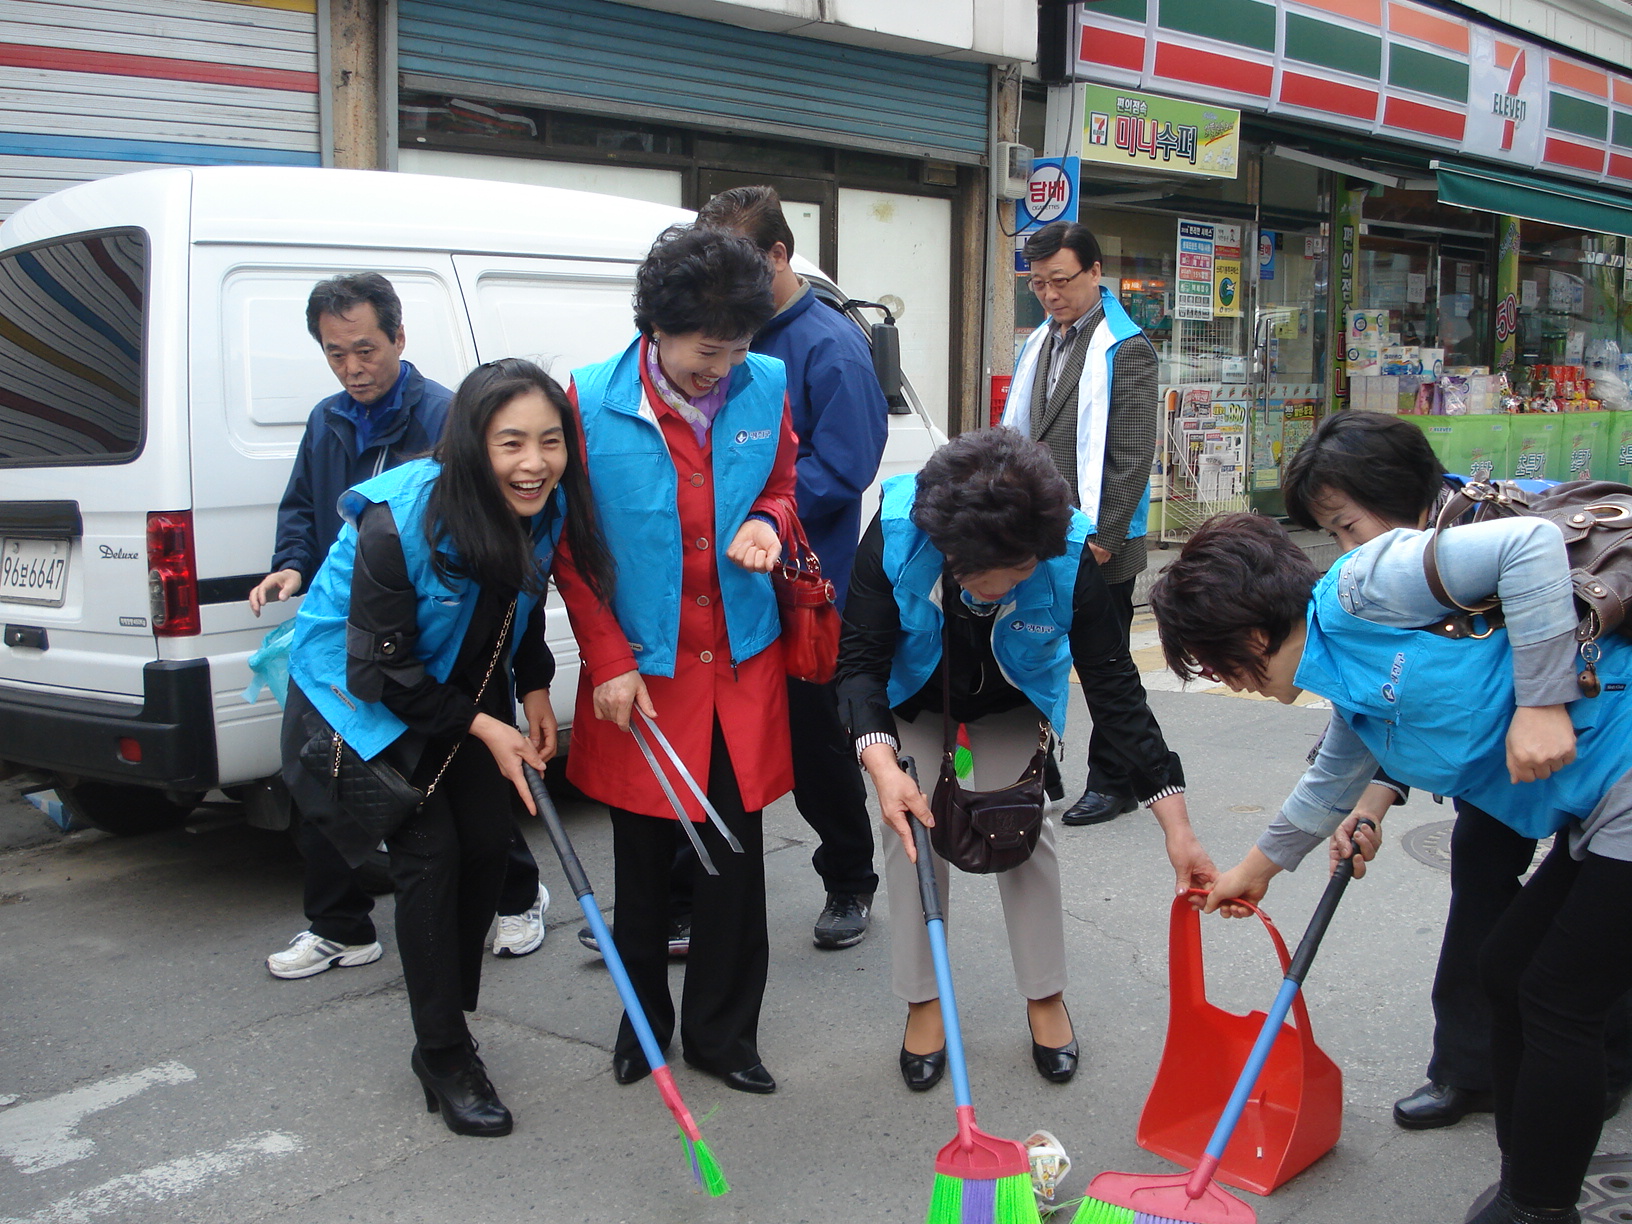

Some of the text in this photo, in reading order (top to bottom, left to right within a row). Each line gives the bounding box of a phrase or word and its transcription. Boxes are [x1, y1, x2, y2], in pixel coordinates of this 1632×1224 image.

[1116, 96, 1148, 117] 편의점속
[1492, 93, 1527, 120] ELEVEN
[1115, 115, 1198, 165] 미니수퍼
[1030, 180, 1065, 203] 담배
[1496, 292, 1517, 342] 50
[1515, 453, 1546, 479] 초특가
[99, 544, 139, 560] Deluxe
[4, 556, 65, 590] 96보6647
